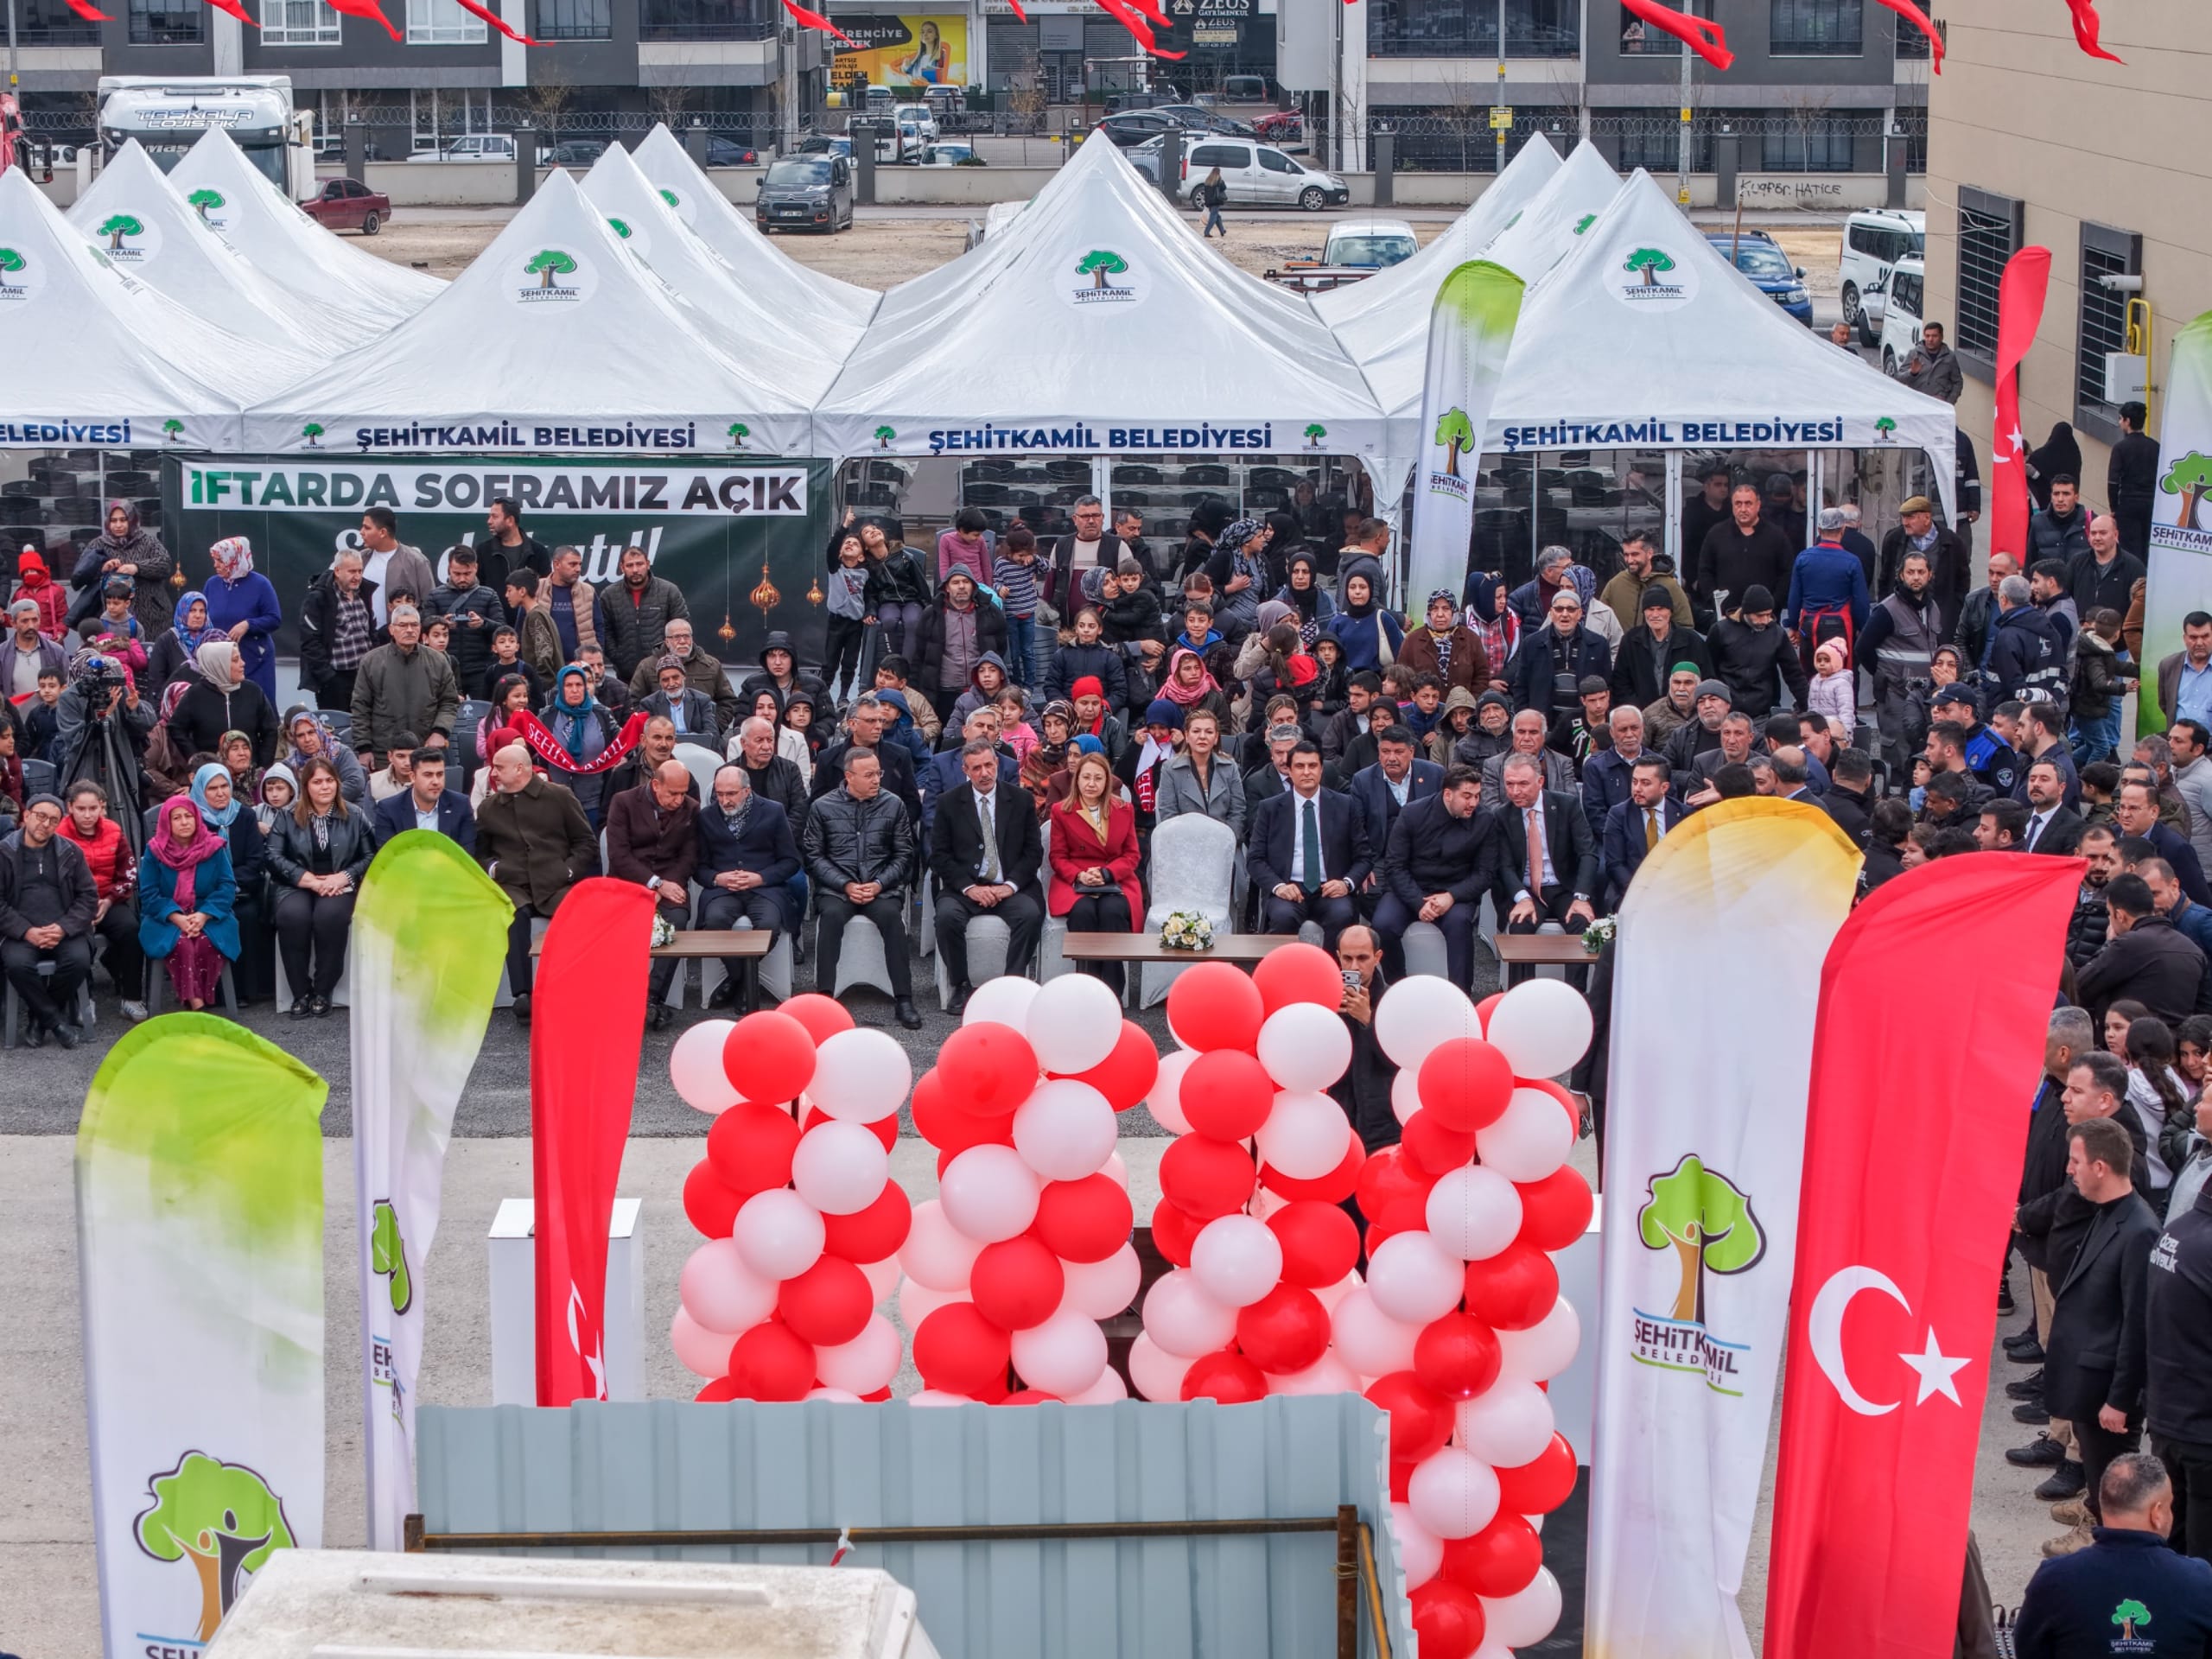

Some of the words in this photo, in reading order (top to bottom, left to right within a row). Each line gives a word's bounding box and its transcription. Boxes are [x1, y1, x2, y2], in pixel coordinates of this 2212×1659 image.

[356, 420, 525, 453] ŞEHİTKAMİL
[534, 421, 696, 448] BELEDİYESİ
[929, 423, 1100, 454] ŞEHİTKAMİL
[1109, 422, 1271, 448] BELEDİYESİ
[1503, 417, 1674, 452] ŞEHİTKAMİL
[1682, 416, 1843, 442] BELEDİYESİ
[415, 472, 668, 510] SOFRAMIZ
[682, 475, 802, 514] AÇIK
[1635, 1318, 1738, 1374] ŞEHiTKMiL
